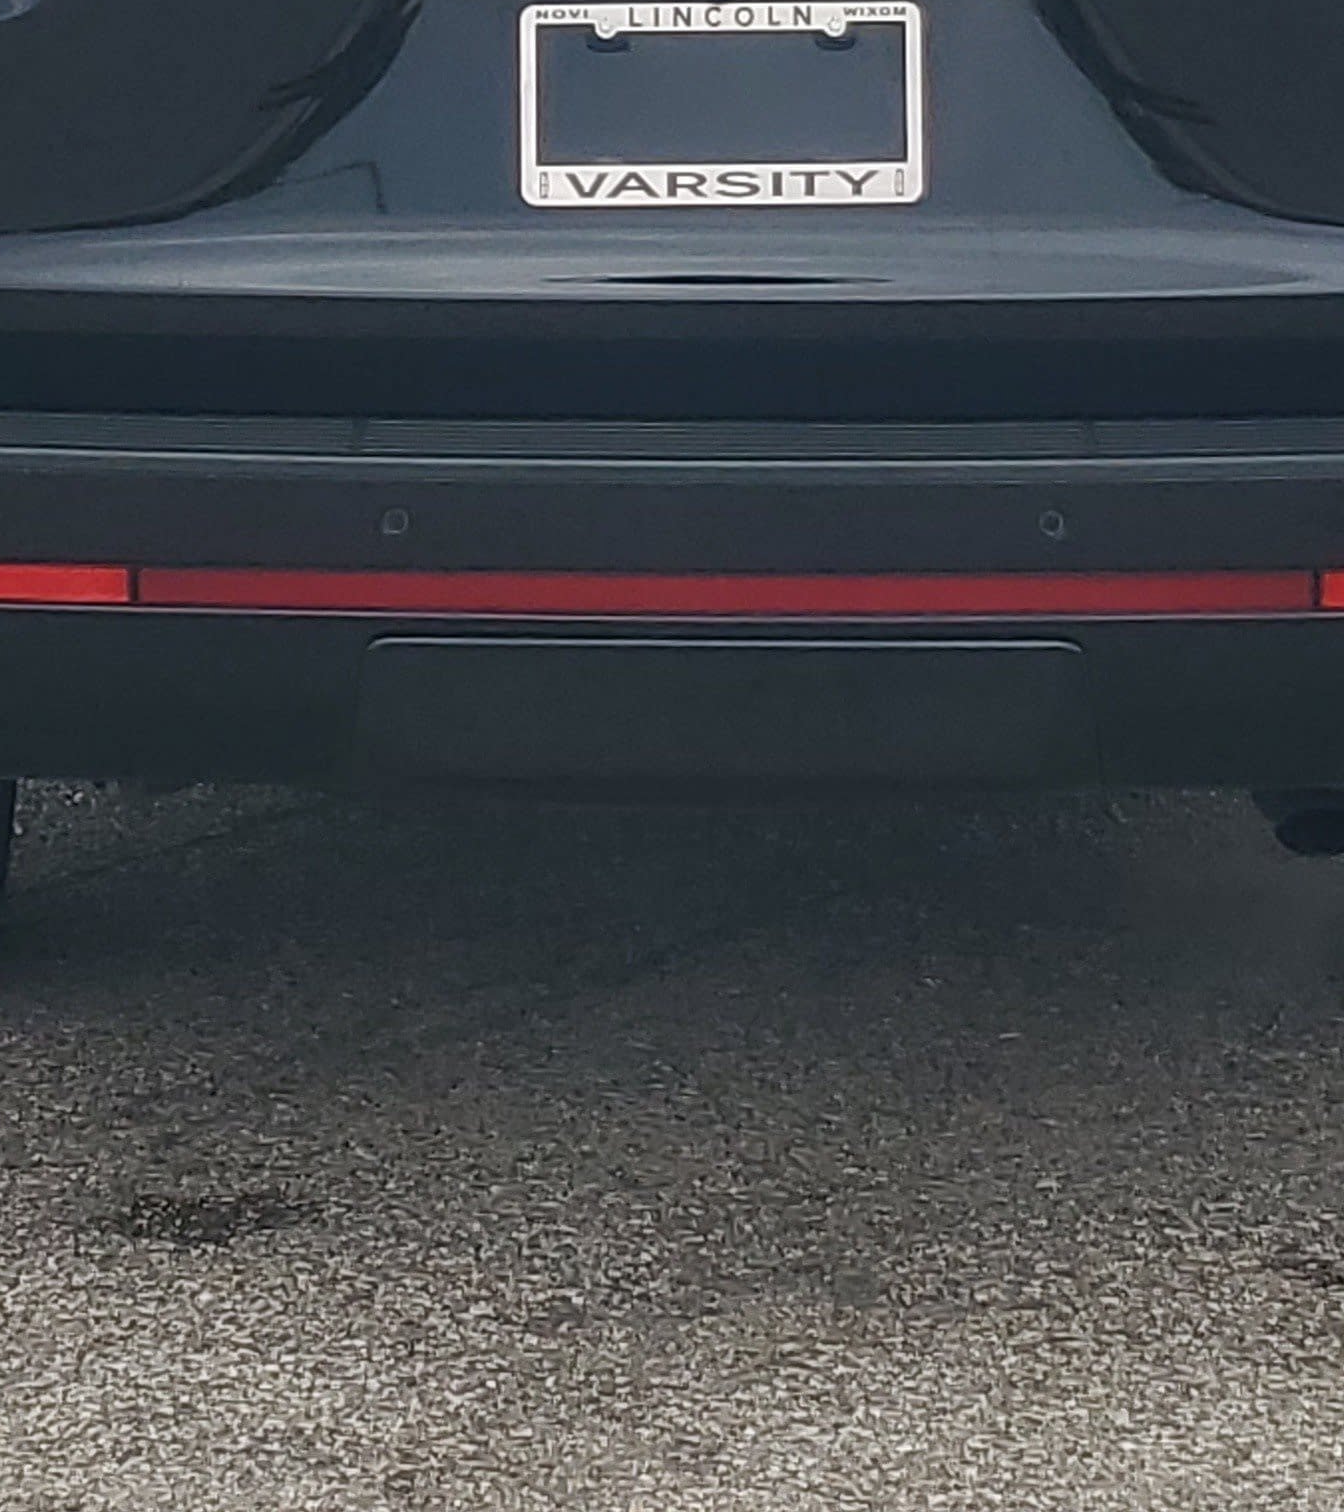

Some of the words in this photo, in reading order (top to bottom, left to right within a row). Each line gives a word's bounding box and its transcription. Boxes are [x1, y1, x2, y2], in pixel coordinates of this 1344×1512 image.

[536, 8, 588, 19] NOVI
[628, 5, 814, 28] LINCOLN
[843, 6, 907, 16] WIXOM
[565, 171, 879, 198] VARSITY
